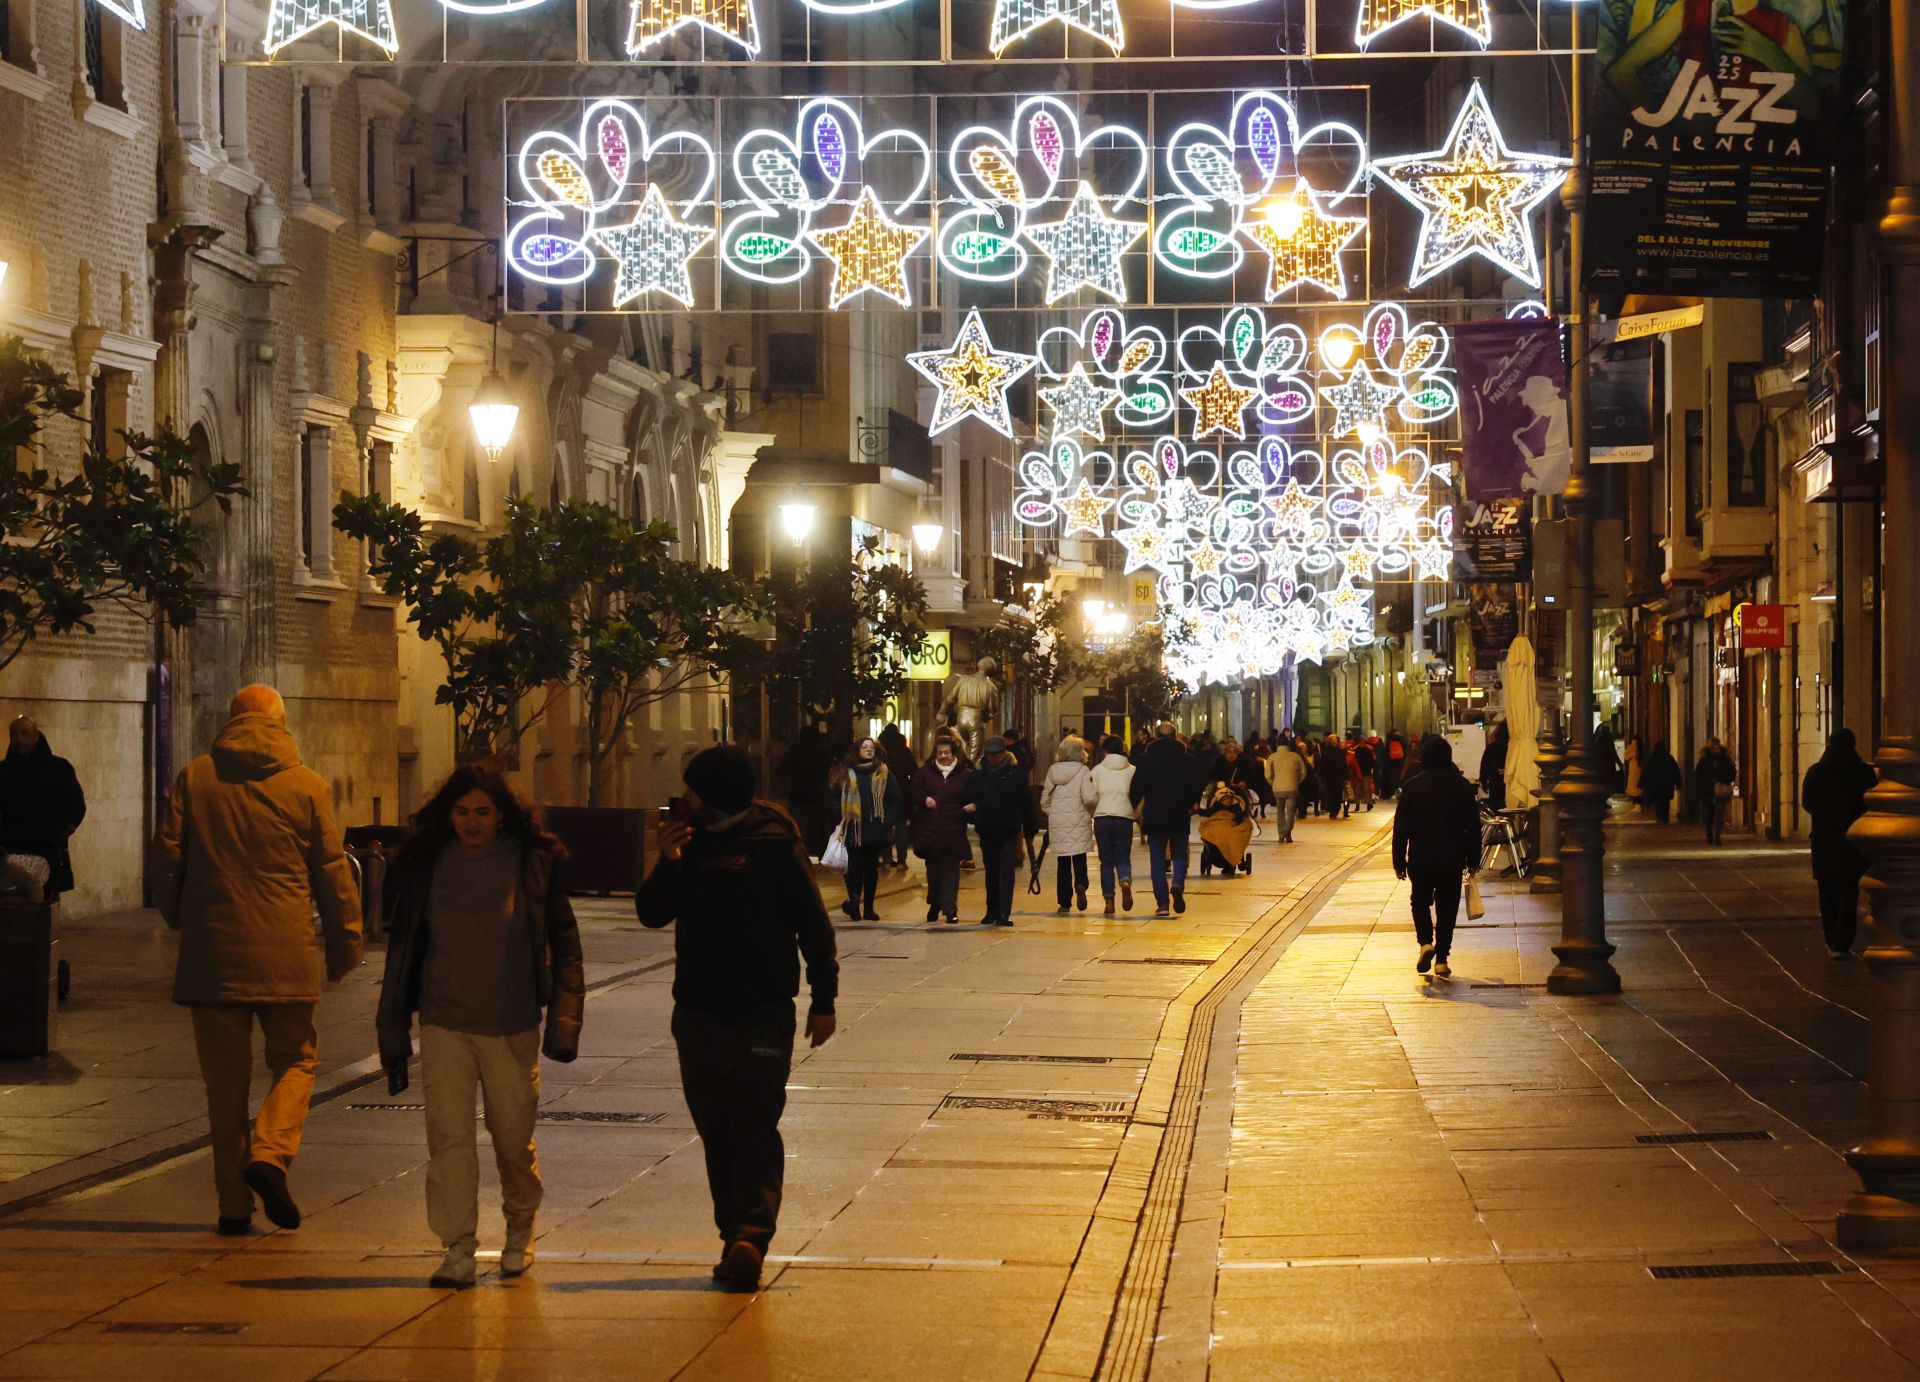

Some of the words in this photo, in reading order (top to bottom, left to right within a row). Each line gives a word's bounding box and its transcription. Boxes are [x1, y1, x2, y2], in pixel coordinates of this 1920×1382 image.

[1631, 58, 1798, 135] JAZZ
[1637, 234, 1657, 243] DEL
[1667, 235, 1680, 244] AL
[1682, 236, 1695, 245] 22
[1696, 237, 1710, 246] DE
[1711, 239, 1771, 249] NOVIEMBRE
[1636, 246, 1770, 261] www.jazzpalencia.es
[1618, 316, 1687, 337] CaixaForum
[1489, 368, 1522, 405] PALENCIA
[1464, 503, 1519, 530] JAZZ
[1477, 601, 1511, 616] JAZZ
